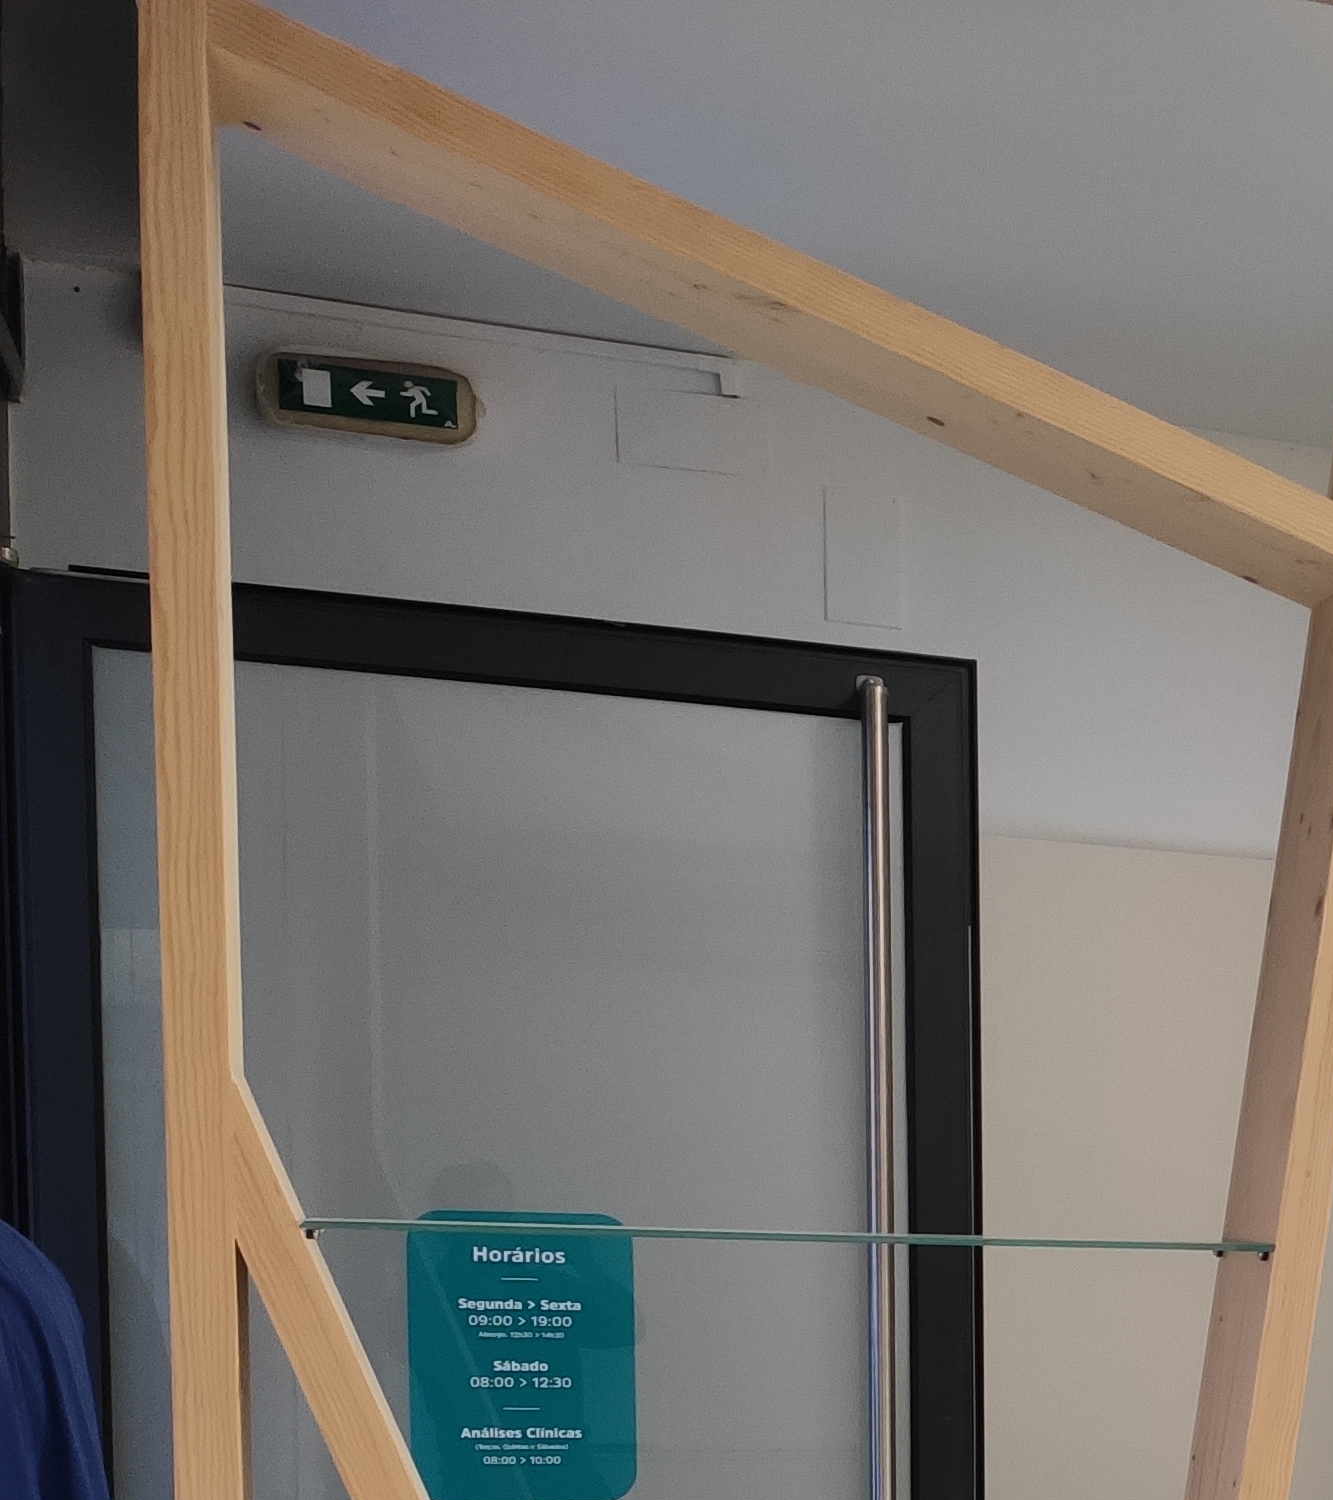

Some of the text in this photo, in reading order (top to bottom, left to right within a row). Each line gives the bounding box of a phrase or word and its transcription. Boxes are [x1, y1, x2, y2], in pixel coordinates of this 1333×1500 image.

[472, 1246, 566, 1264] Horários
[457, 1298, 523, 1313] Segunda
[540, 1299, 582, 1311] Sexta
[468, 1315, 513, 1327] 09:00
[530, 1315, 573, 1327] 19:00
[493, 1360, 549, 1372] Sábado
[470, 1376, 515, 1388] 08:00
[532, 1376, 572, 1388] 12:30
[460, 1427, 583, 1439] Análises Clínicas
[482, 1455, 517, 1465] 08:00
[529, 1455, 562, 1465] 10:00
